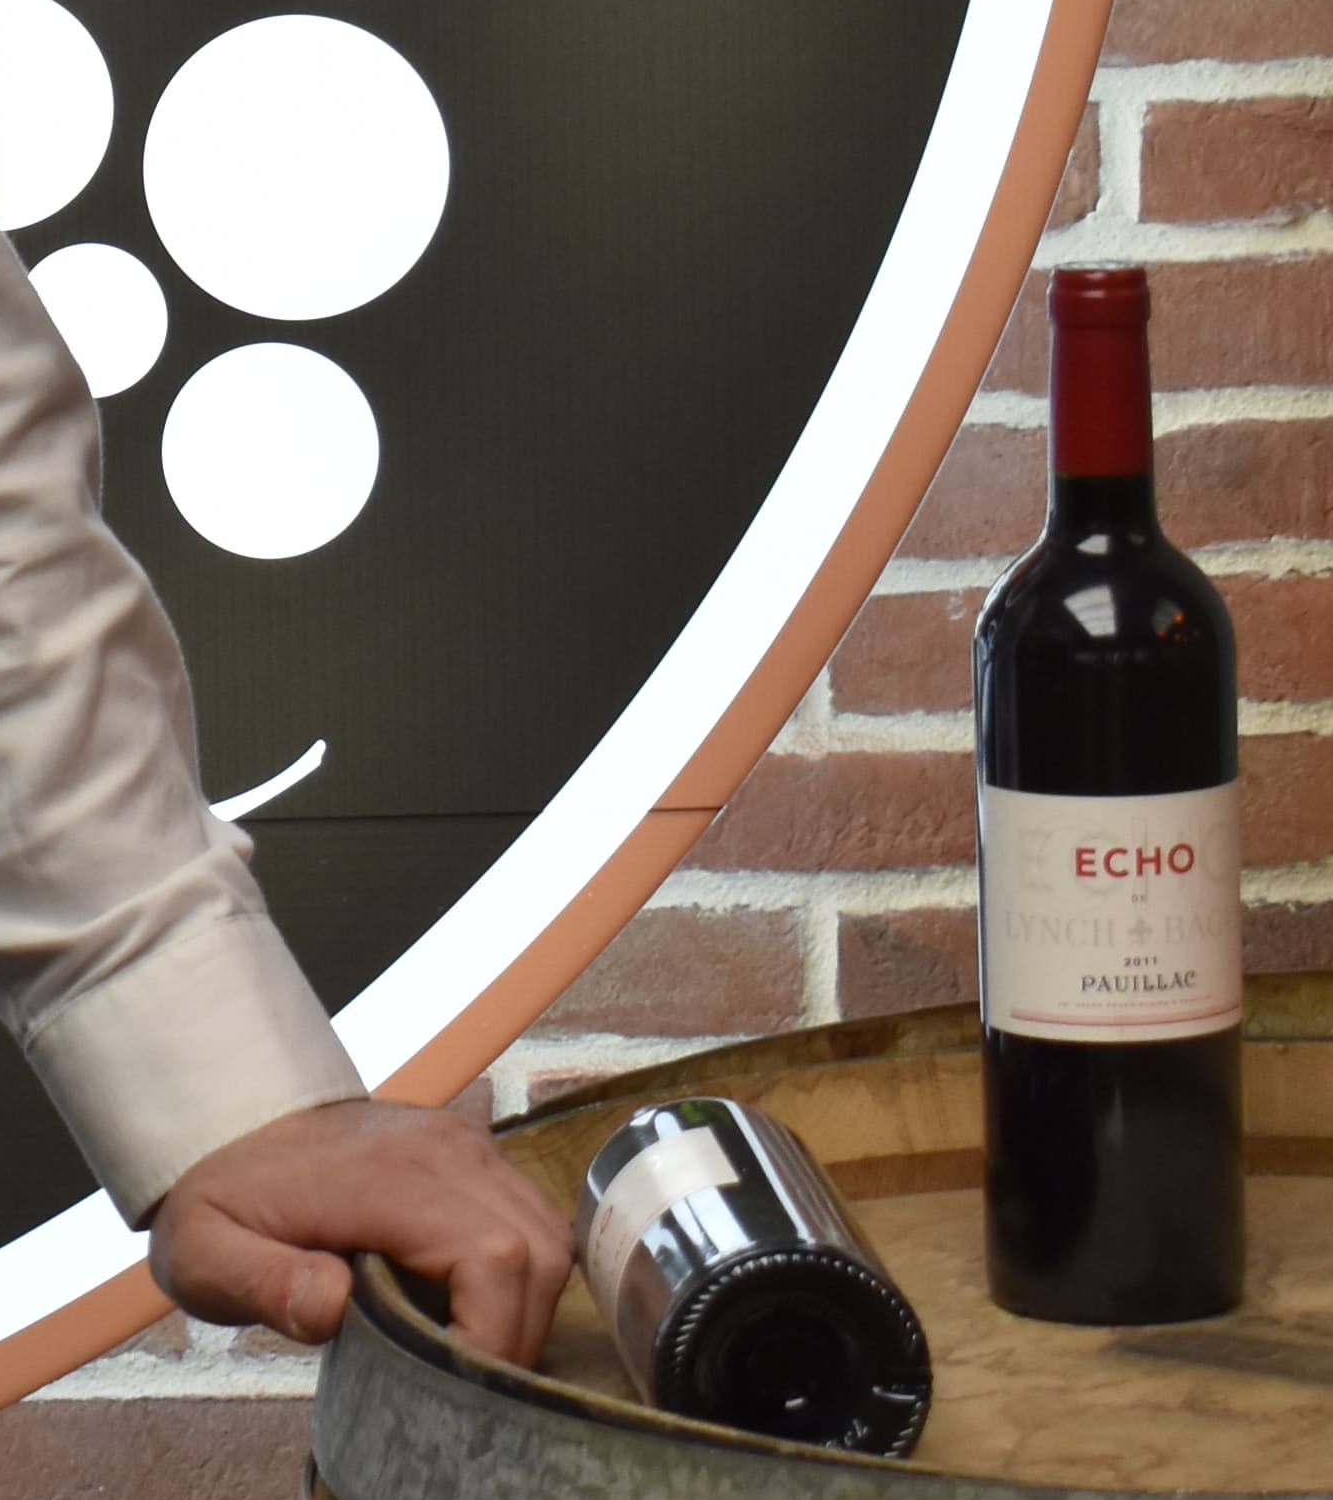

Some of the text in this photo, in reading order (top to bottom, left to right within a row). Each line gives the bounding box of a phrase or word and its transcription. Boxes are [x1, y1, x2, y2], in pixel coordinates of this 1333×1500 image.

[1074, 843, 1195, 878] ECHO
[1004, 908, 1224, 948] LYNCH BAG
[1081, 970, 1197, 993] PAUILLAC
